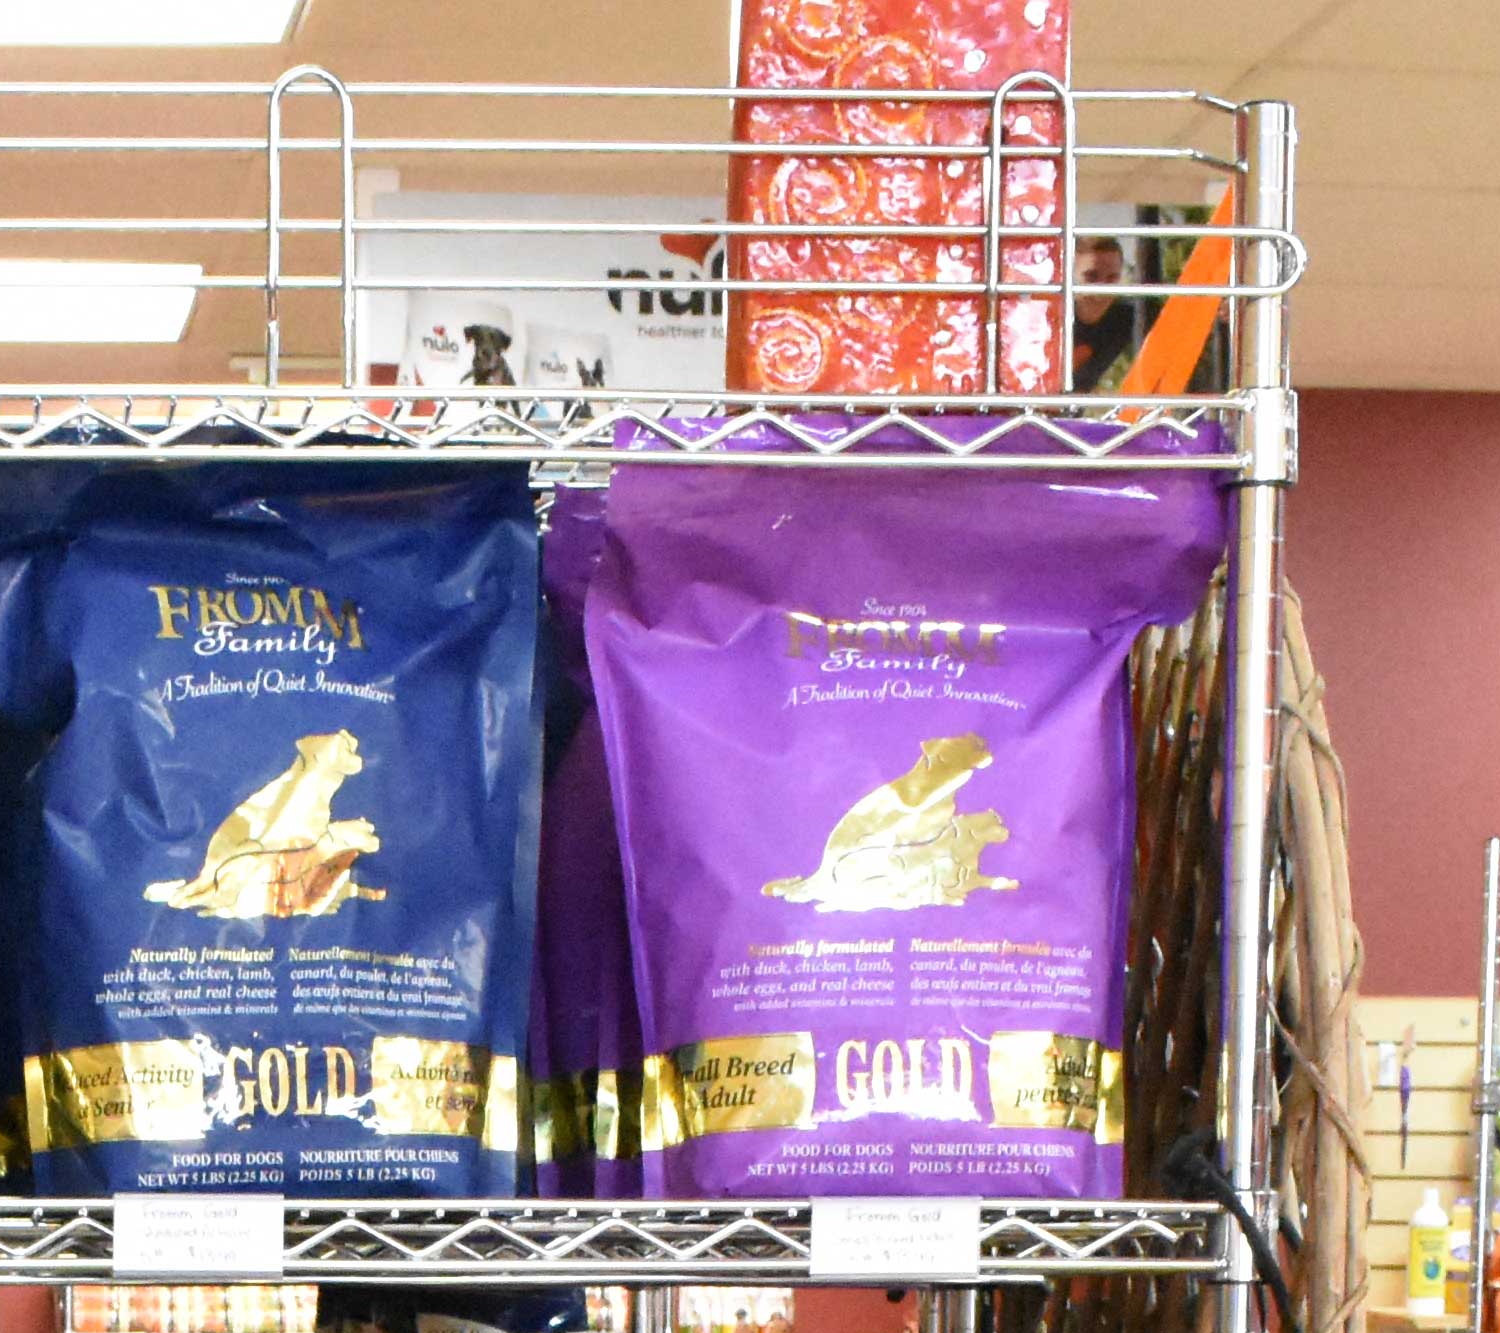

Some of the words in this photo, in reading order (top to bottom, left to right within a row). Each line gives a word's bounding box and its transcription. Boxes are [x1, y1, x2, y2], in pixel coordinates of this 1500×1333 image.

[148, 584, 365, 651] FROMM
[194, 622, 336, 664] Family
[820, 648, 965, 678] Family
[160, 680, 174, 701] A
[175, 672, 243, 699] Tradition
[246, 669, 262, 698] of
[264, 669, 306, 692] Quiet
[309, 671, 390, 703] Innovation
[800, 683, 871, 705] Tradition
[874, 680, 888, 704] of
[891, 680, 933, 699] Quiet
[129, 947, 197, 965] Naturally
[199, 947, 274, 964] formulated
[221, 1046, 356, 1117] GOLD
[725, 1053, 795, 1078] Breed
[836, 1037, 972, 1112] GOLD
[173, 1152, 212, 1168] FOOD
[215, 1152, 242, 1167] FOR
[246, 1151, 283, 1166] DOGS
[299, 1149, 382, 1164] NOURRITURE
[385, 1149, 417, 1164] POUR
[419, 1149, 459, 1164] CHIENS
